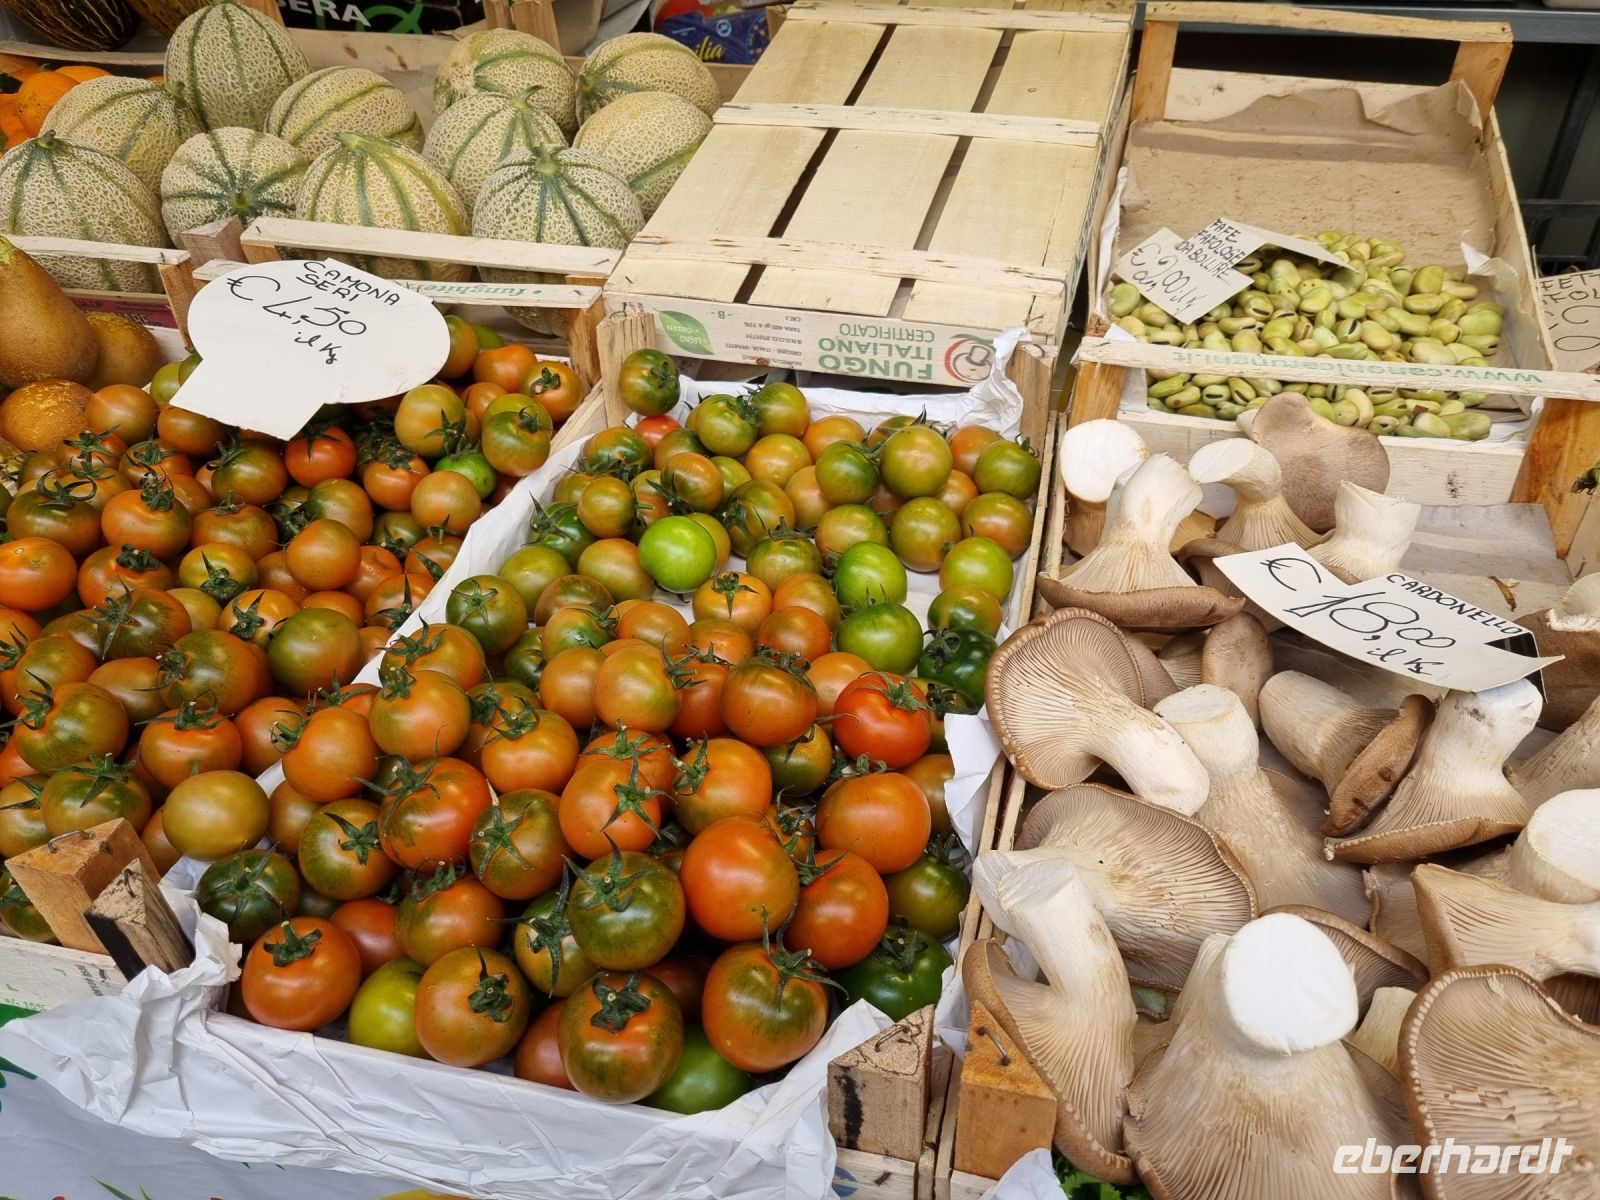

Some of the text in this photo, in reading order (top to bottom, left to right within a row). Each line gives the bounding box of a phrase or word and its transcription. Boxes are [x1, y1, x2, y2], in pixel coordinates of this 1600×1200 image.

[262, 296, 367, 336] 4,50
[838, 322, 936, 343] CERTIFICATO
[818, 337, 933, 360] ITALIANO
[818, 354, 933, 381] FUNGO
[1386, 574, 1523, 635] CARDONELLO
